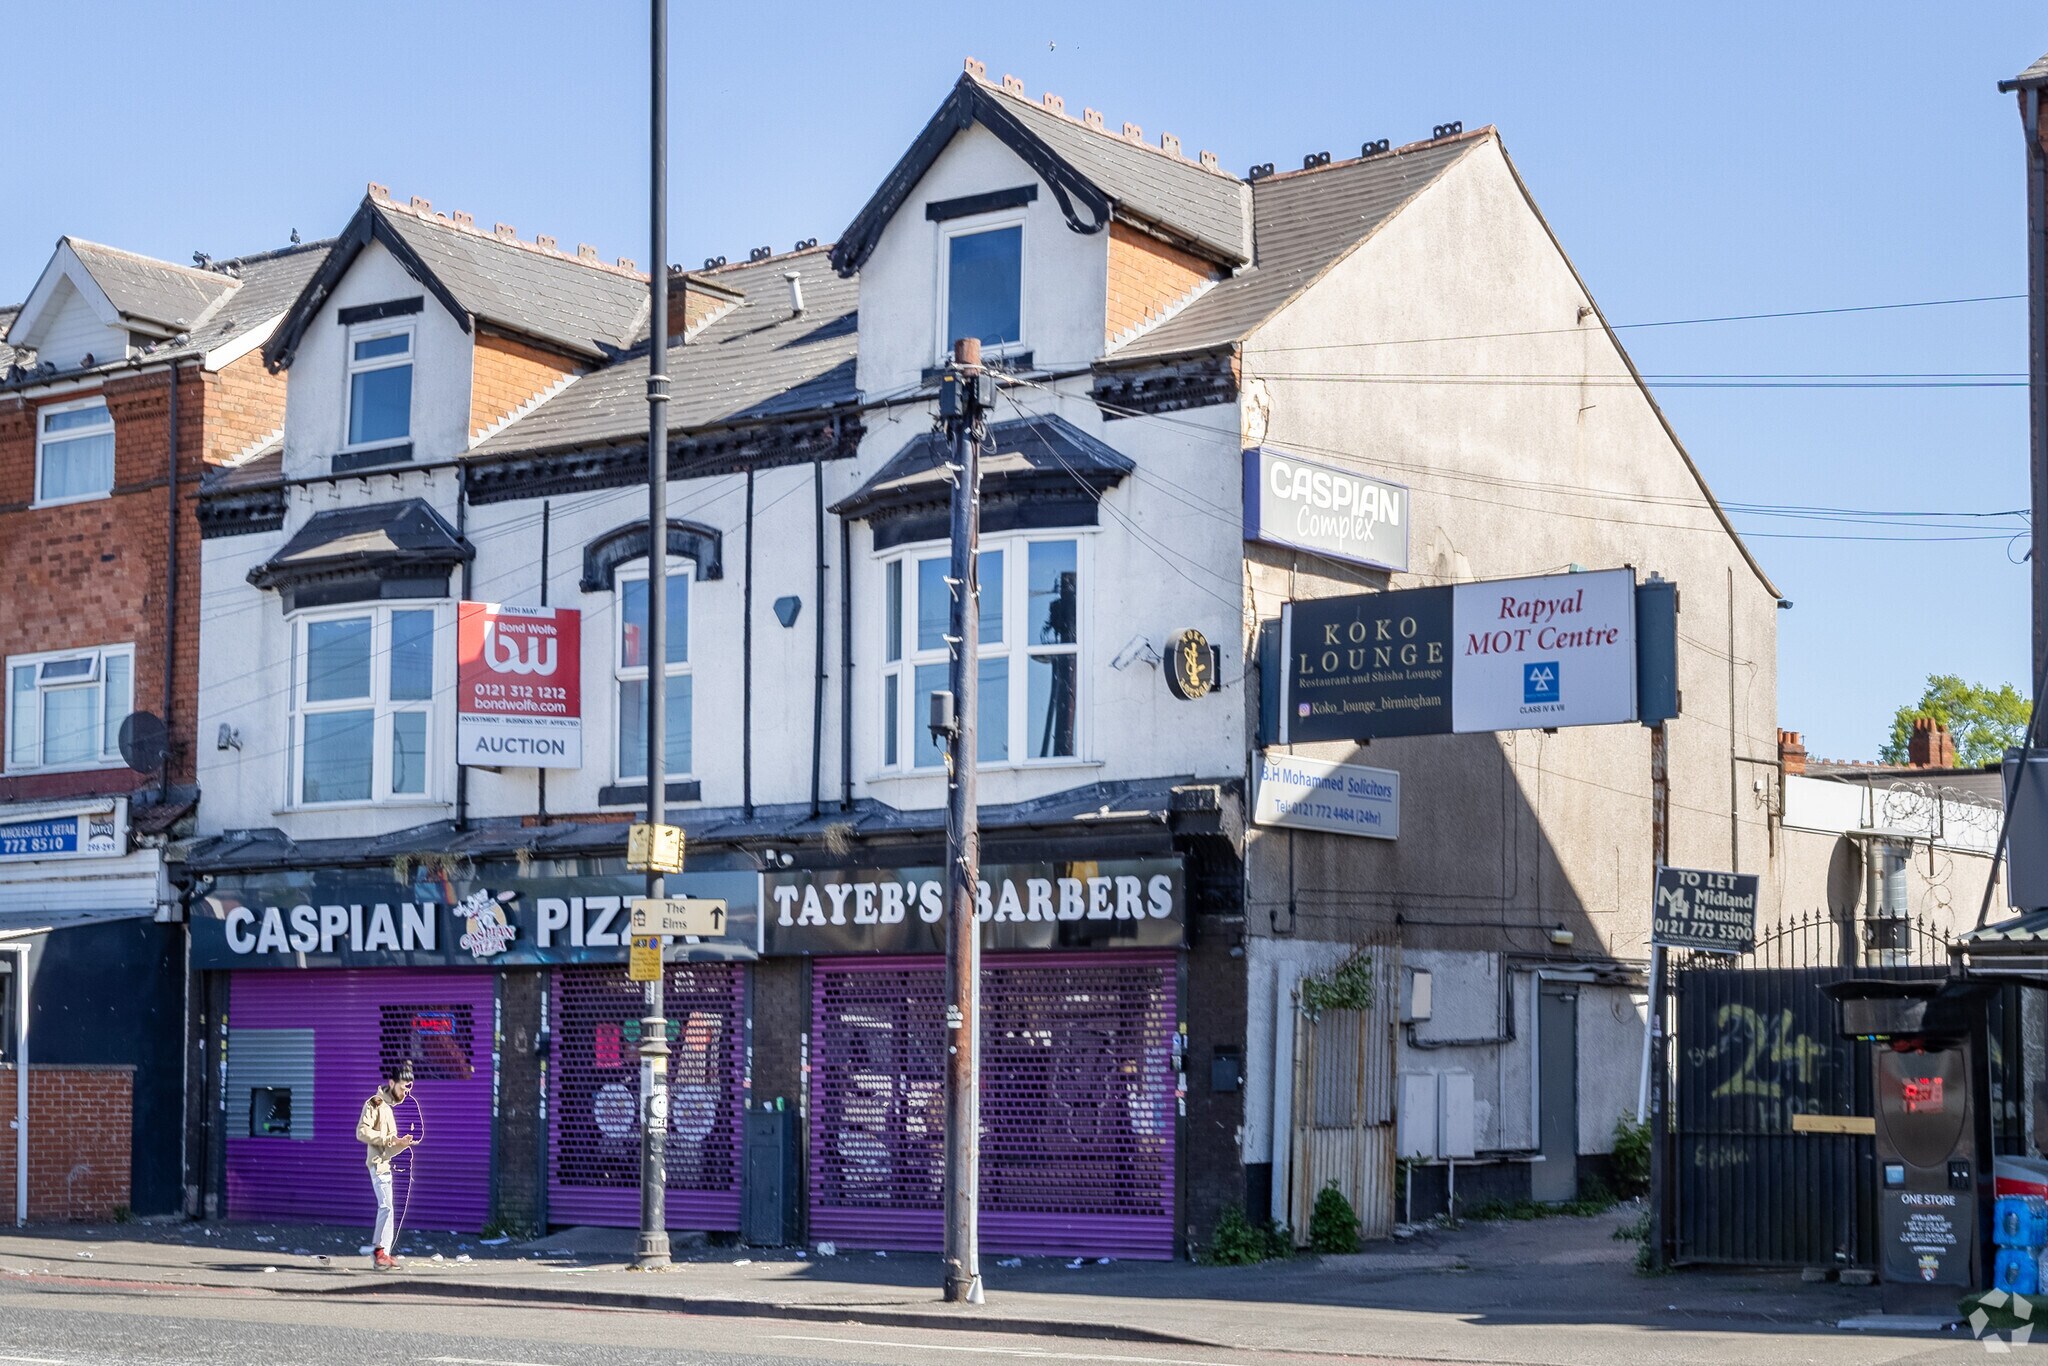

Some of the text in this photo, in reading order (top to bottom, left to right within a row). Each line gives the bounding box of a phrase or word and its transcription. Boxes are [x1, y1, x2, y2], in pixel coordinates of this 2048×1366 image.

[1270, 461, 1400, 526] CASPIAN
[1297, 505, 1375, 550] Complex
[521, 607, 538, 616] MAY
[1497, 588, 1584, 624] Rapyal
[498, 621, 558, 636] Bond Wolfe
[1323, 616, 1418, 646] KOKO
[1464, 625, 1619, 656] MOT Centre
[1298, 642, 1444, 675] LOUNGE
[1298, 668, 1443, 689] Restaurant and Shisha Lounge
[474, 683, 567, 701] 0121 312 1212
[474, 696, 567, 714] bondwolfe.com
[1519, 705, 1541, 714] CLASS
[461, 715, 500, 724] INVESTMENT
[505, 718, 533, 726] BUSINESS
[475, 736, 565, 755] AUCTION
[1261, 765, 1392, 798] B.H Mohammed Solicitors
[1275, 799, 1381, 827] Tel: 0121 772 4464 (24hr)
[43, 824, 51, 837] &
[52, 823, 77, 836] RETAIL
[3, 836, 64, 854] 772 8510
[1677, 871, 1738, 890] TO LET
[665, 902, 686, 914] The
[773, 879, 943, 926] TAYEB'S
[1694, 888, 1754, 909] Midland
[536, 893, 700, 948] PIZ
[662, 917, 688, 930] Elms
[1693, 903, 1753, 927] Housing
[225, 902, 436, 954] CASPIAN
[460, 925, 516, 950] CASPIAN
[1654, 917, 1685, 935] 0121
[1689, 920, 1716, 938] 773
[1717, 923, 1754, 941] 5500
[471, 939, 507, 958] PIZZA
[1712, 1004, 1820, 1099] 24
[1901, 1193, 1956, 1207] ONE STORE
